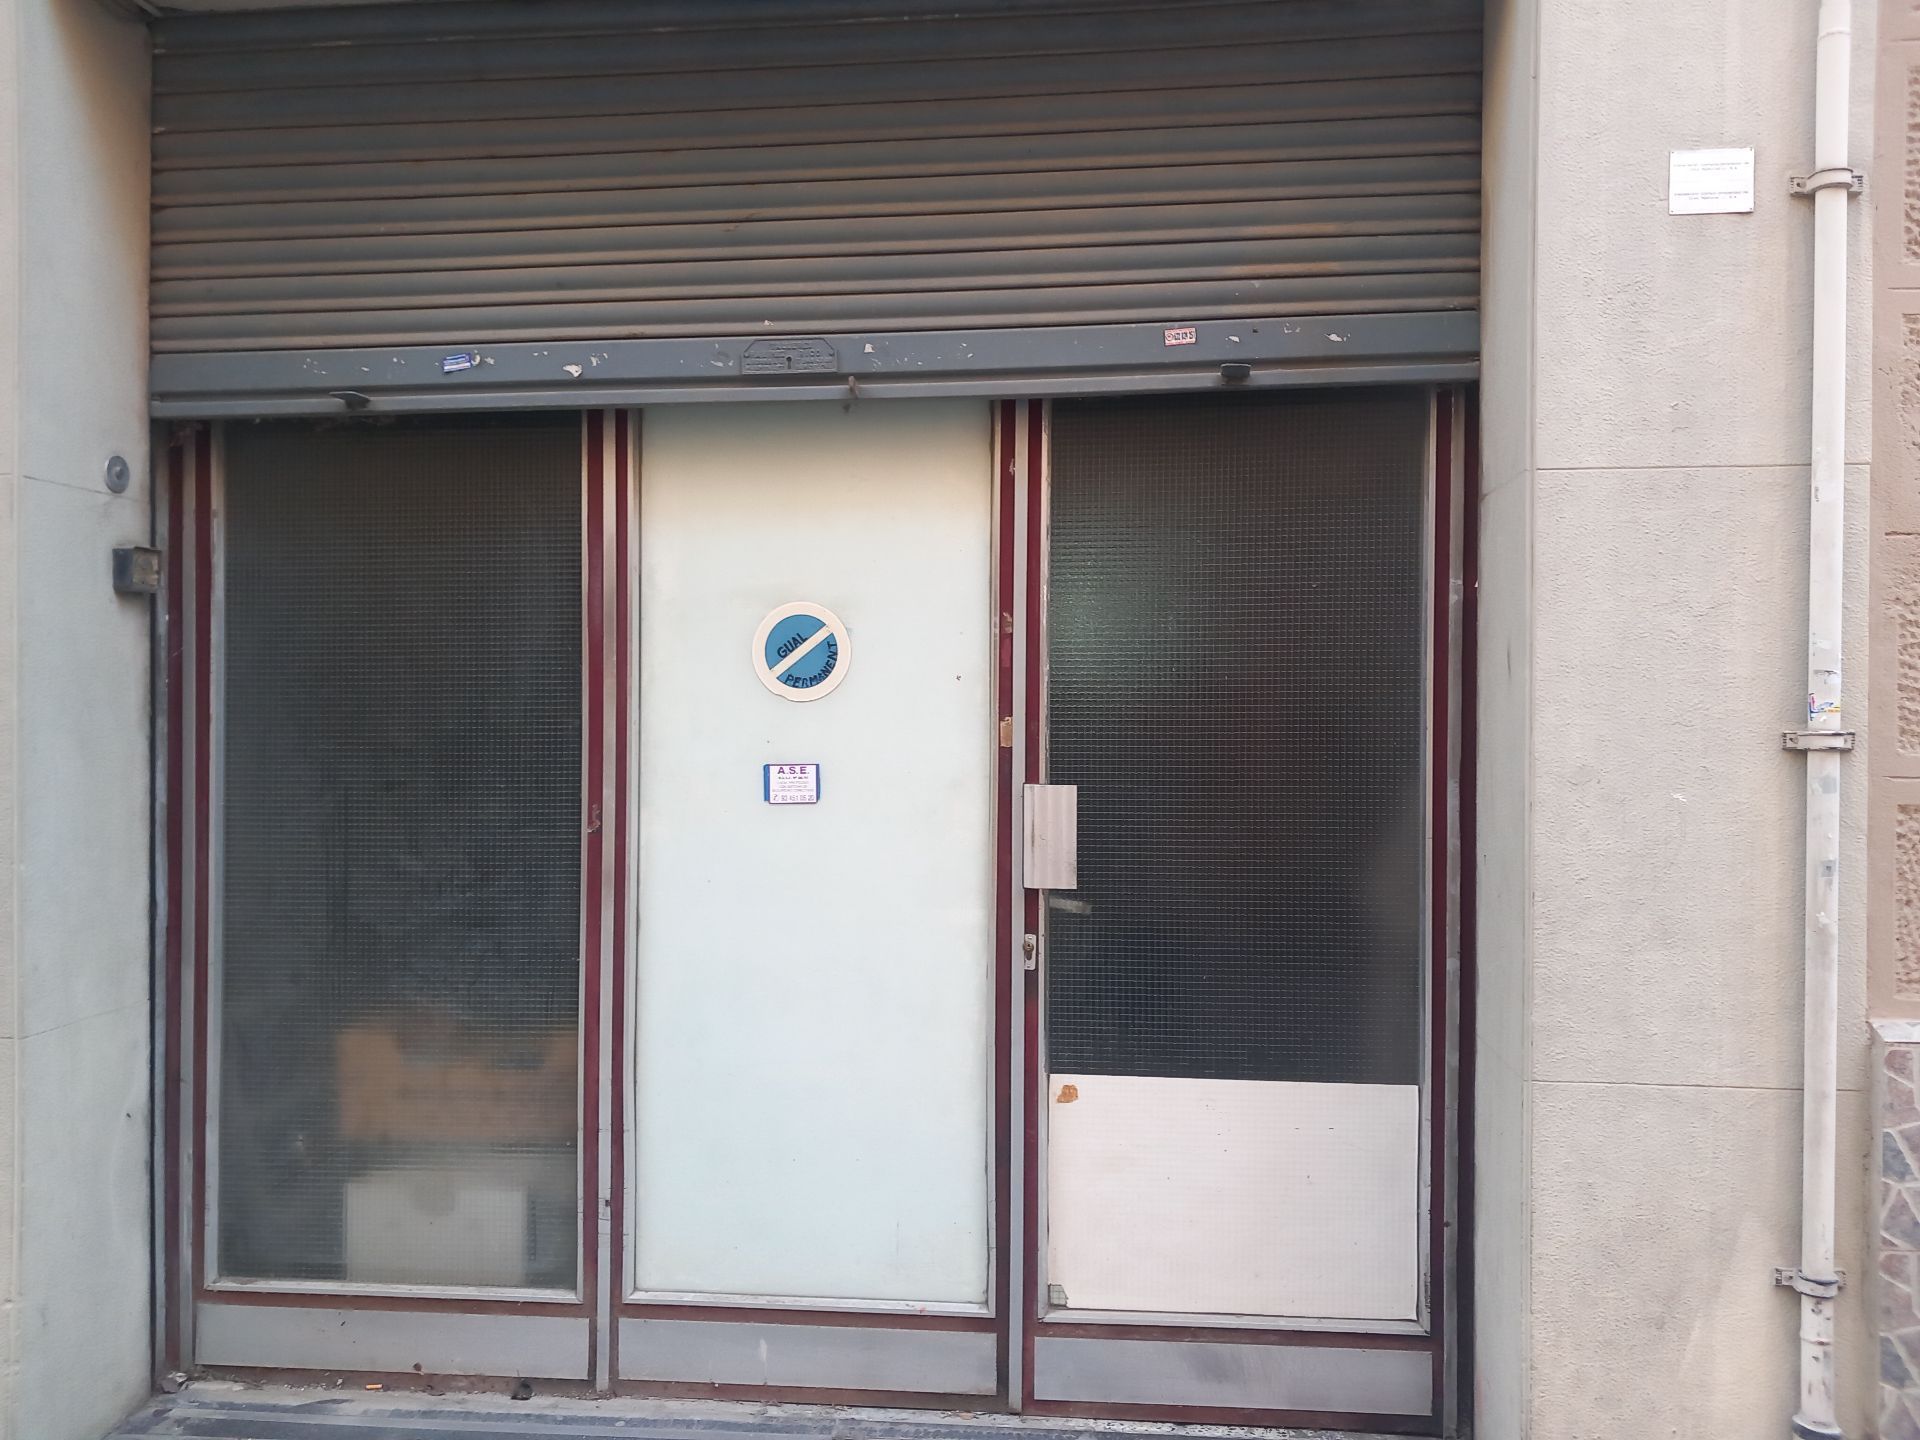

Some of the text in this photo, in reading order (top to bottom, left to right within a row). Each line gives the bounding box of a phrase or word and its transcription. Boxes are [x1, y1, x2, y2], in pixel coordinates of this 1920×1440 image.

[777, 632, 808, 659] GUAL
[785, 641, 838, 688] PERMANENT
[777, 766, 810, 774] A.S.E.
